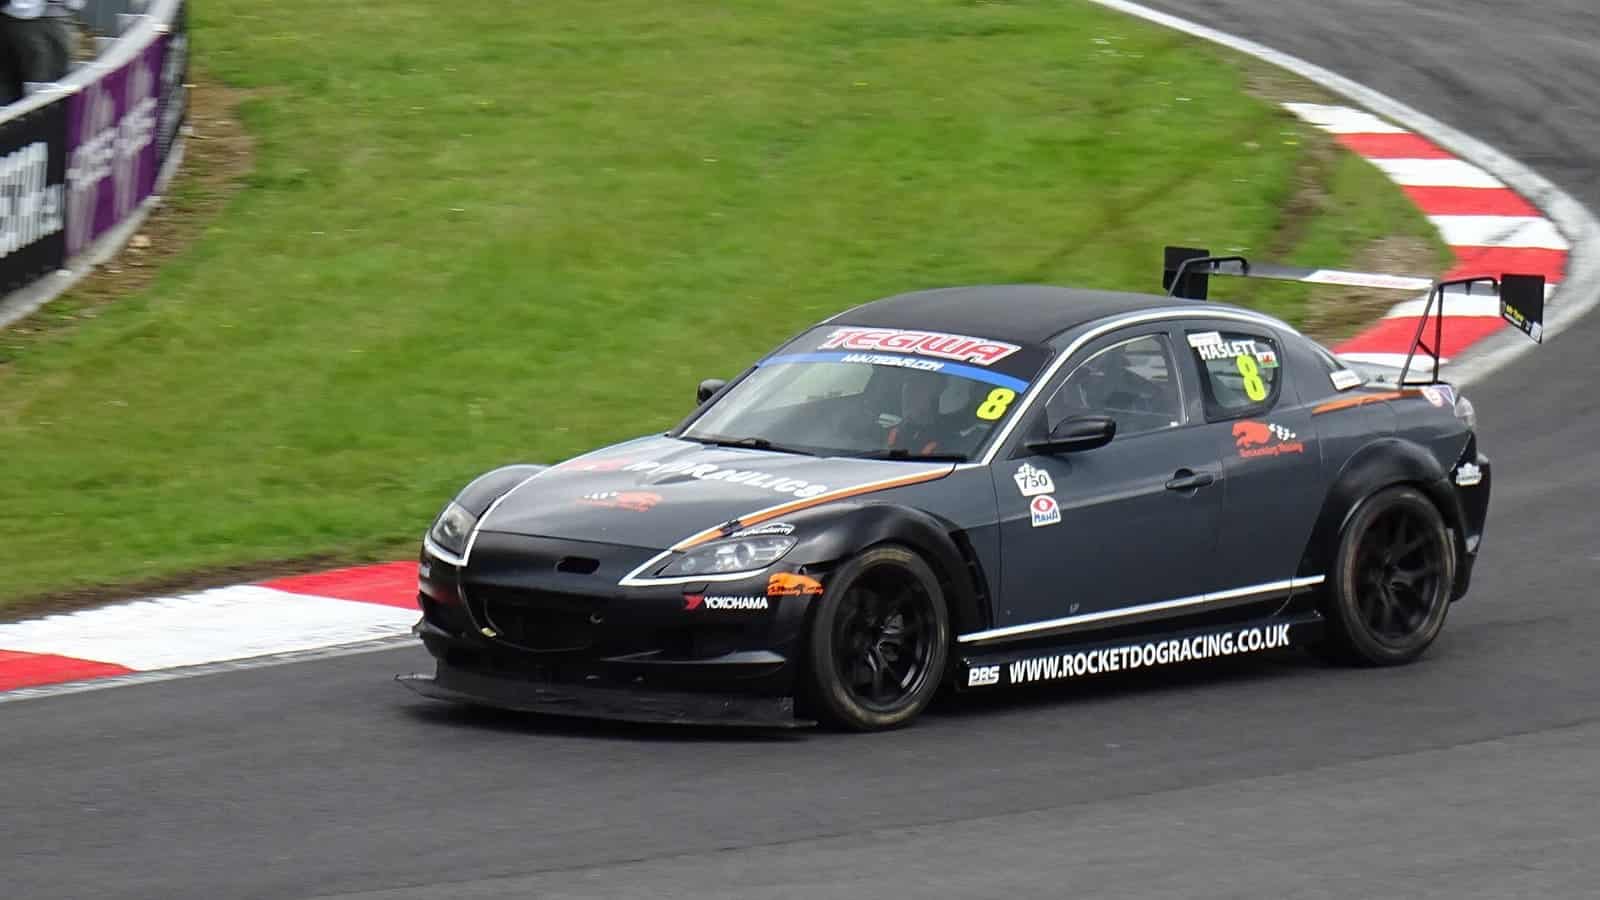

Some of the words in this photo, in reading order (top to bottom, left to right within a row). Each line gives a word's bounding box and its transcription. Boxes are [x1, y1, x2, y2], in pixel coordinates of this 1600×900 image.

[820, 327, 1021, 366] TEGIWA
[1198, 340, 1257, 361] HASLETT
[1236, 354, 1266, 401] 8
[976, 387, 1017, 421] 8
[1019, 473, 1049, 490] 750
[703, 596, 769, 609] YOKOHAMA
[1009, 624, 1290, 684] WWW.ROCKETDOGRACING.CO.UK
